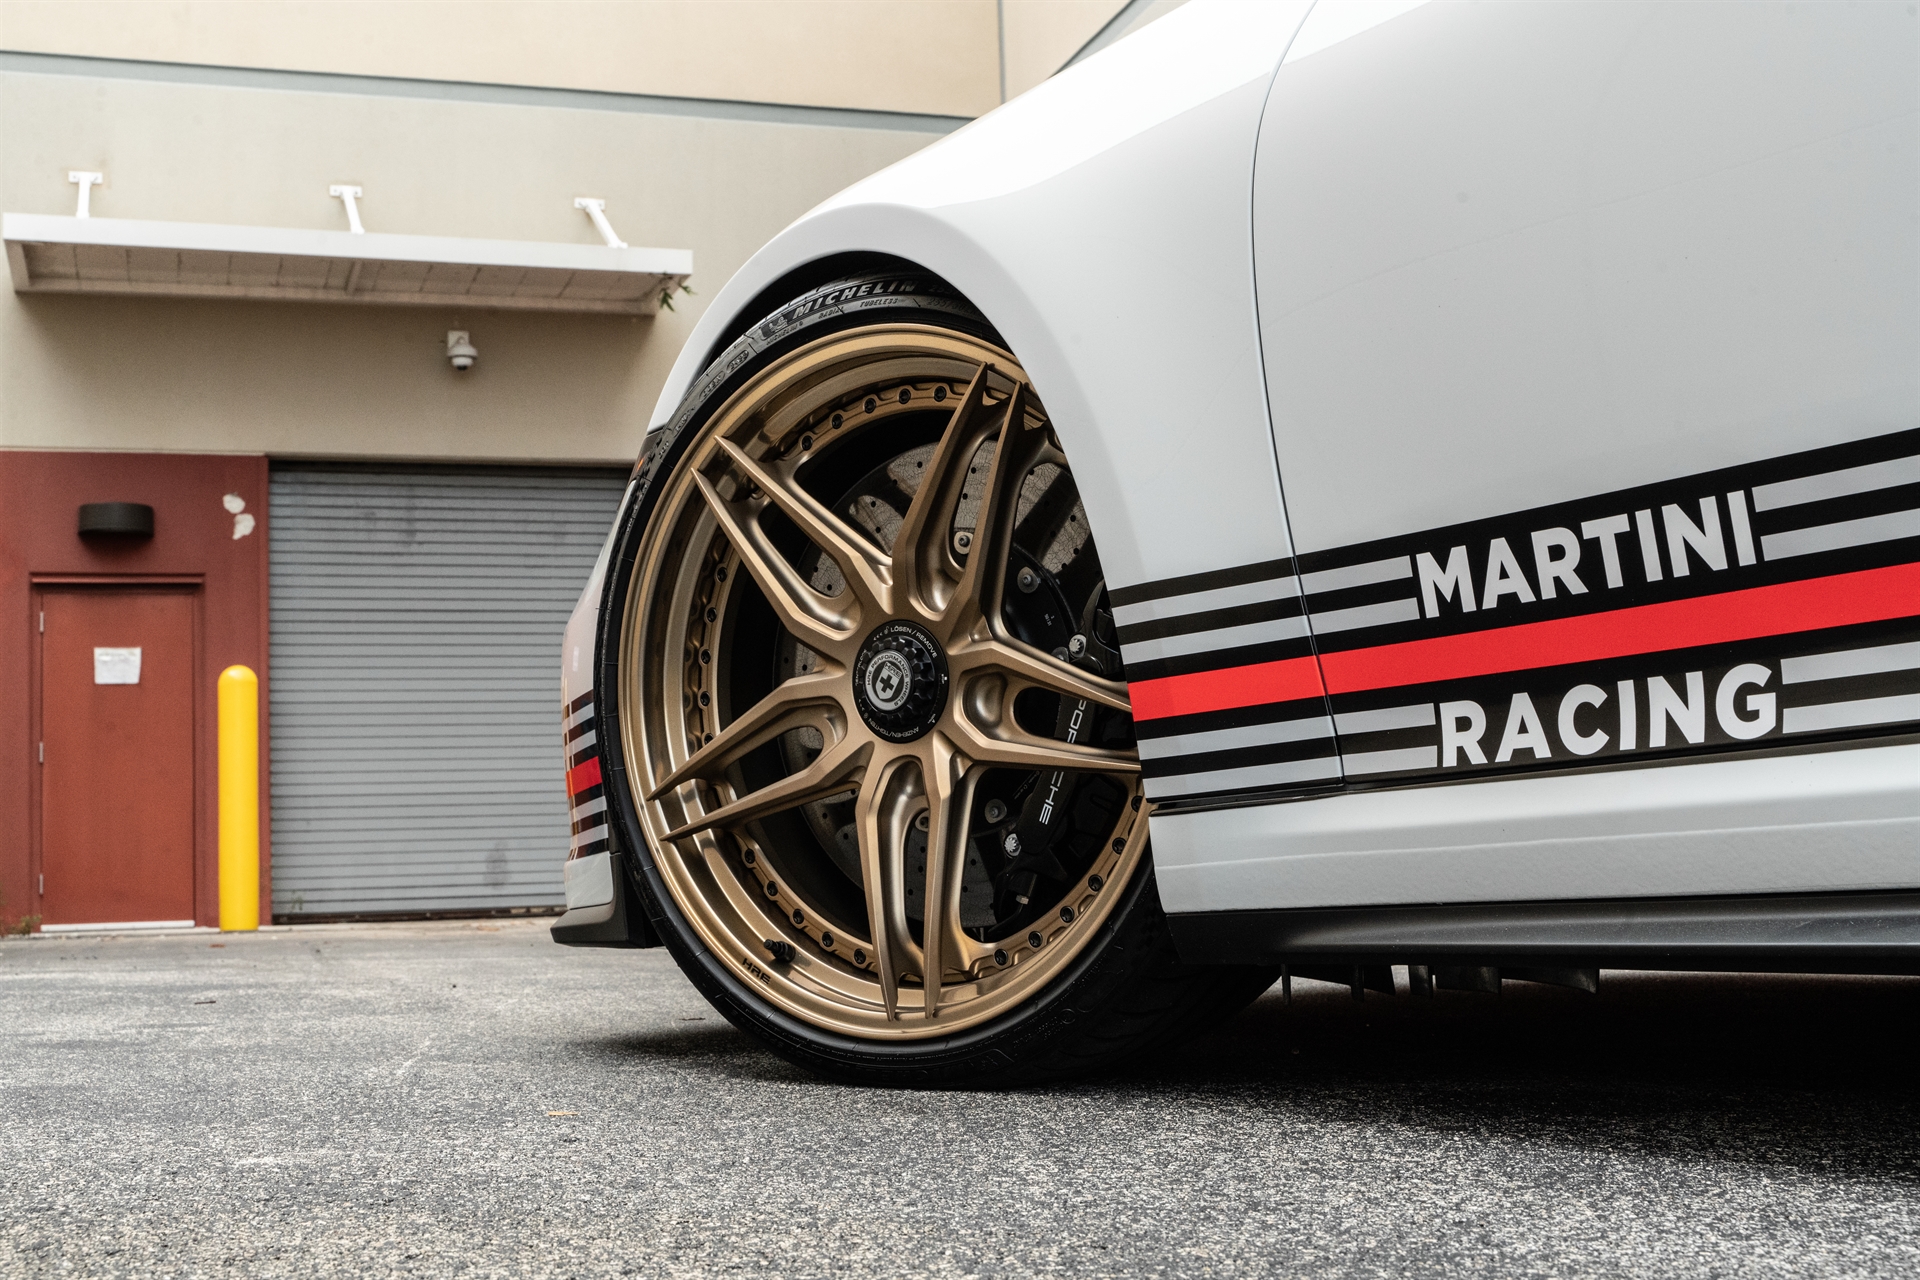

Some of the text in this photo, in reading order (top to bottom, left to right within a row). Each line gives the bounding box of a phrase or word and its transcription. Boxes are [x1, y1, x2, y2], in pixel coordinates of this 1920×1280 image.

[792, 279, 917, 320] MICHELIN
[818, 306, 844, 320] RADIAL
[859, 298, 899, 308] TUBELESS
[1415, 490, 1757, 619] MARTINI
[891, 626, 912, 634] LÖSEN
[915, 632, 938, 658] REMOVE
[871, 654, 909, 679] PERFORMANCE
[893, 681, 910, 707] WHEELS
[884, 661, 902, 678] HRE
[1439, 663, 1776, 768] RACING
[1039, 700, 1087, 825] PORCHE
[742, 958, 771, 985] HRE
